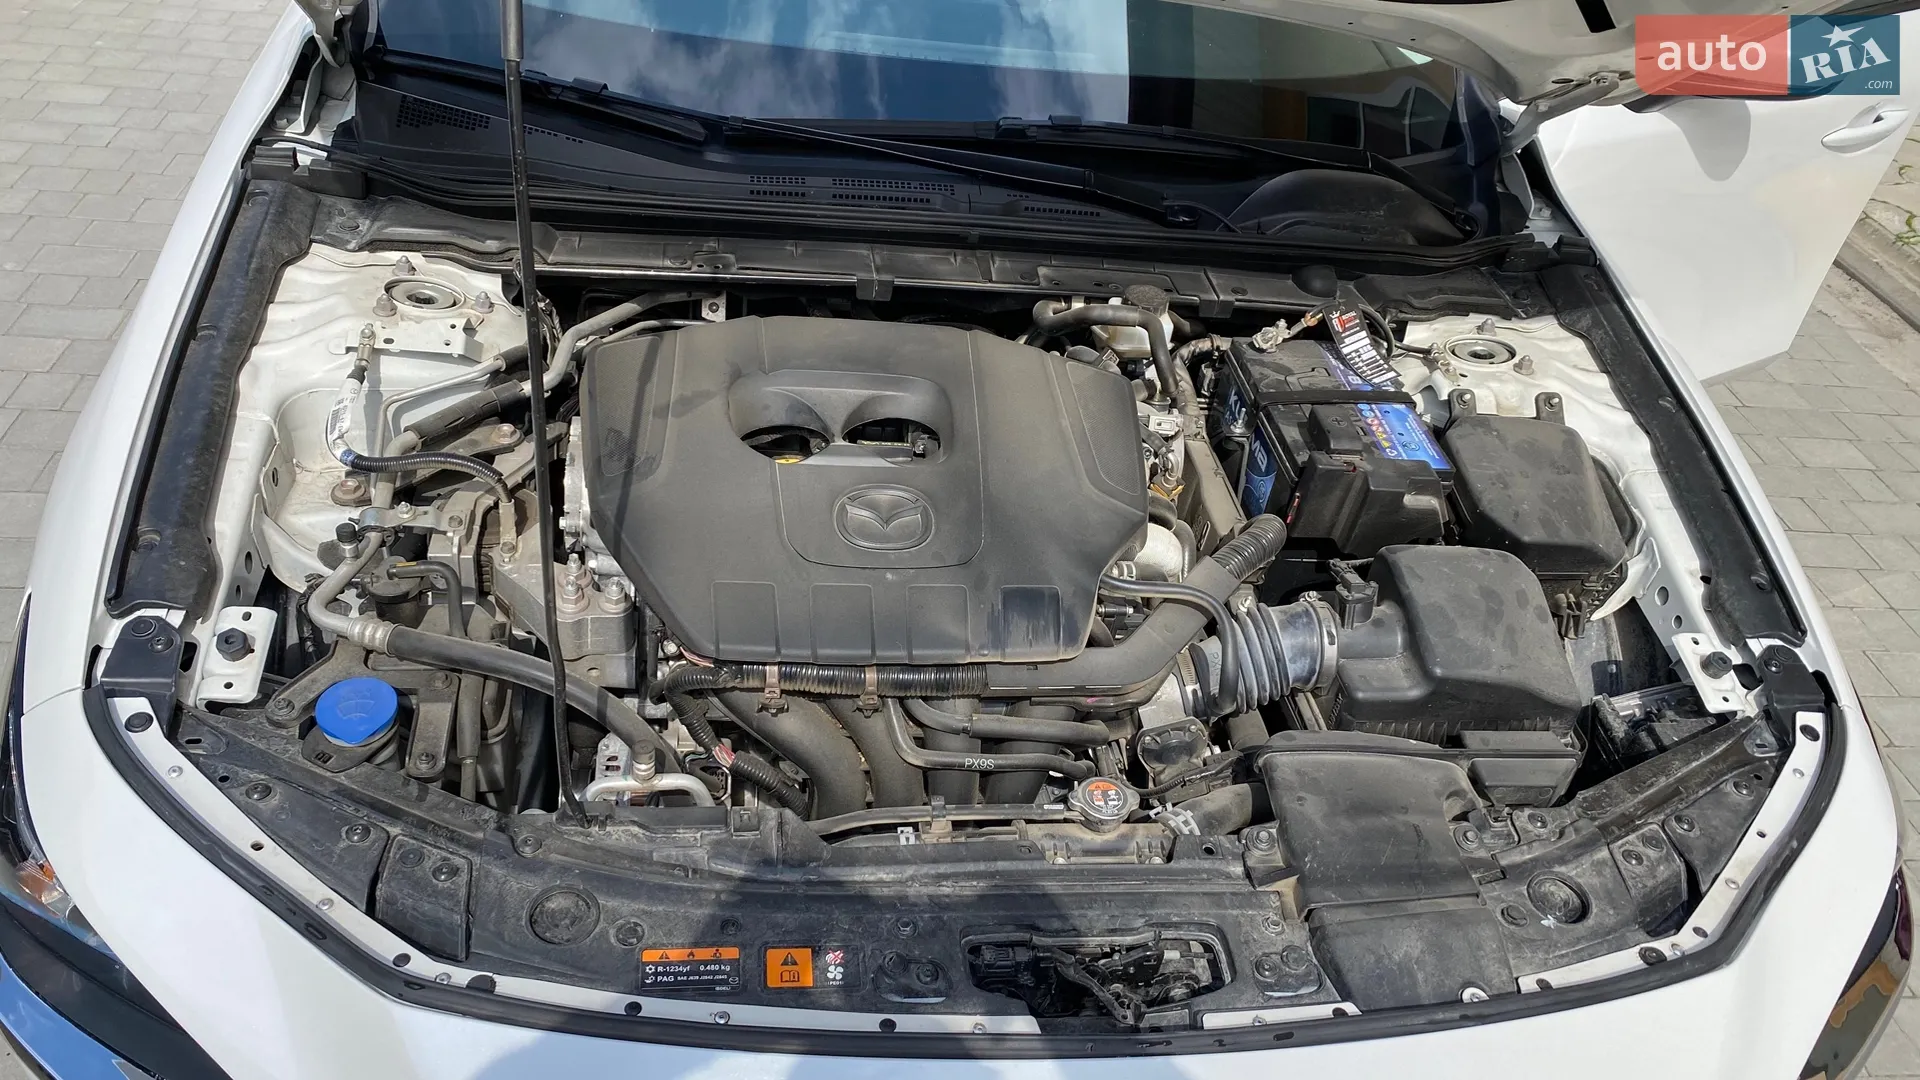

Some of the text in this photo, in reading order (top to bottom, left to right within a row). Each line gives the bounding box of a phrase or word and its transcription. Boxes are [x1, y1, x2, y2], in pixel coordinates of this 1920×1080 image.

[964, 757, 995, 770] PX9S
[657, 965, 691, 973] R-1234yf
[720, 964, 731, 972] kg
[656, 975, 675, 983] PAG
